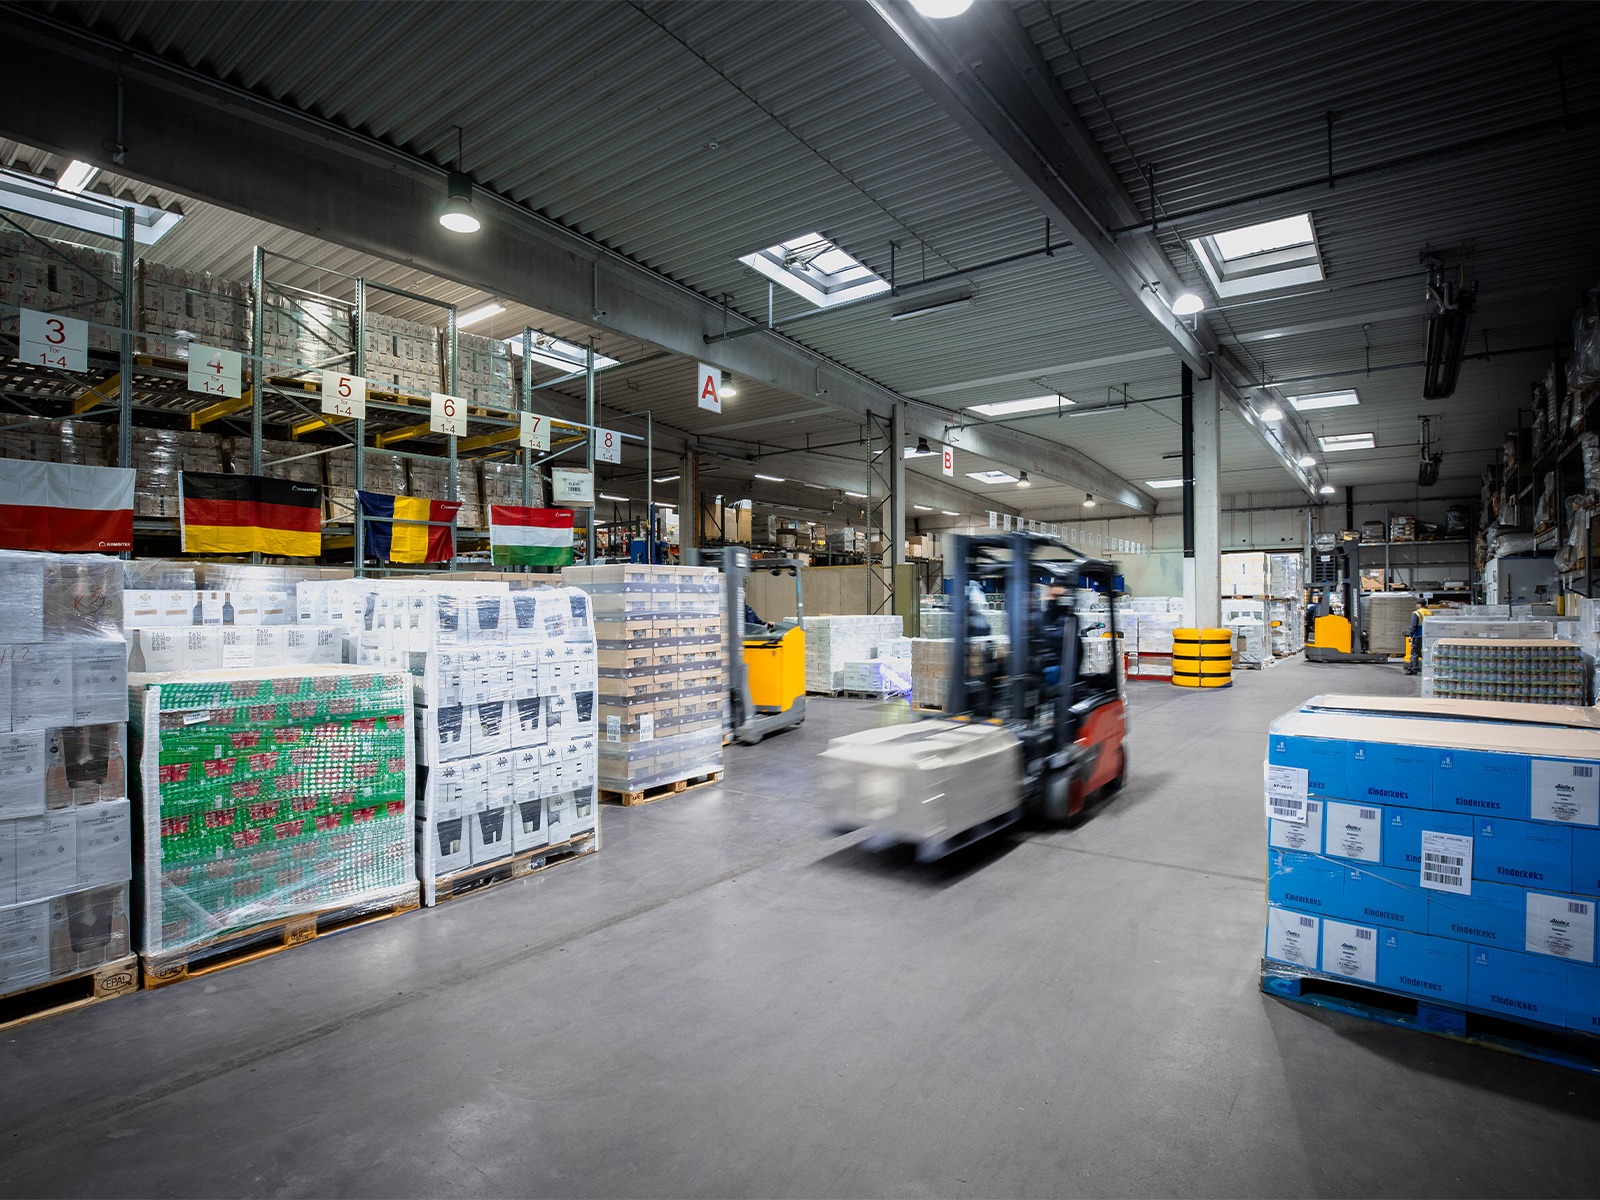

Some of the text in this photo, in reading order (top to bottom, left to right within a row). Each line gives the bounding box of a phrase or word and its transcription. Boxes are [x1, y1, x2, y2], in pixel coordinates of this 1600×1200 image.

[45, 318, 66, 344] 3
[49, 346, 61, 354] Tor
[39, 353, 68, 368] 1-4
[207, 351, 224, 374] 4
[210, 375, 221, 383] Tor
[203, 381, 226, 394] 1-4
[338, 377, 351, 397] 5
[701, 375, 719, 403] A
[334, 404, 353, 416] 1-4
[443, 398, 455, 417] 6
[440, 423, 455, 434] 1-4
[531, 416, 541, 433] 7
[529, 439, 541, 449] 1-4
[604, 432, 613, 448] 8
[602, 453, 613, 462] 1-4
[945, 452, 952, 470] B
[1368, 787, 1409, 799] Kinderkeks
[1456, 797, 1501, 810] Kinderkeks
[1497, 866, 1544, 881] Kinderkeks
[1285, 892, 1322, 906] Kinderkeks
[1364, 907, 1405, 922] Kinderkeks
[1451, 923, 1496, 939] Kinderkeks
[106, 975, 128, 989] EPAL
[1399, 975, 1442, 992] Kinderkeks
[1491, 994, 1538, 1013] Kinderkeks
